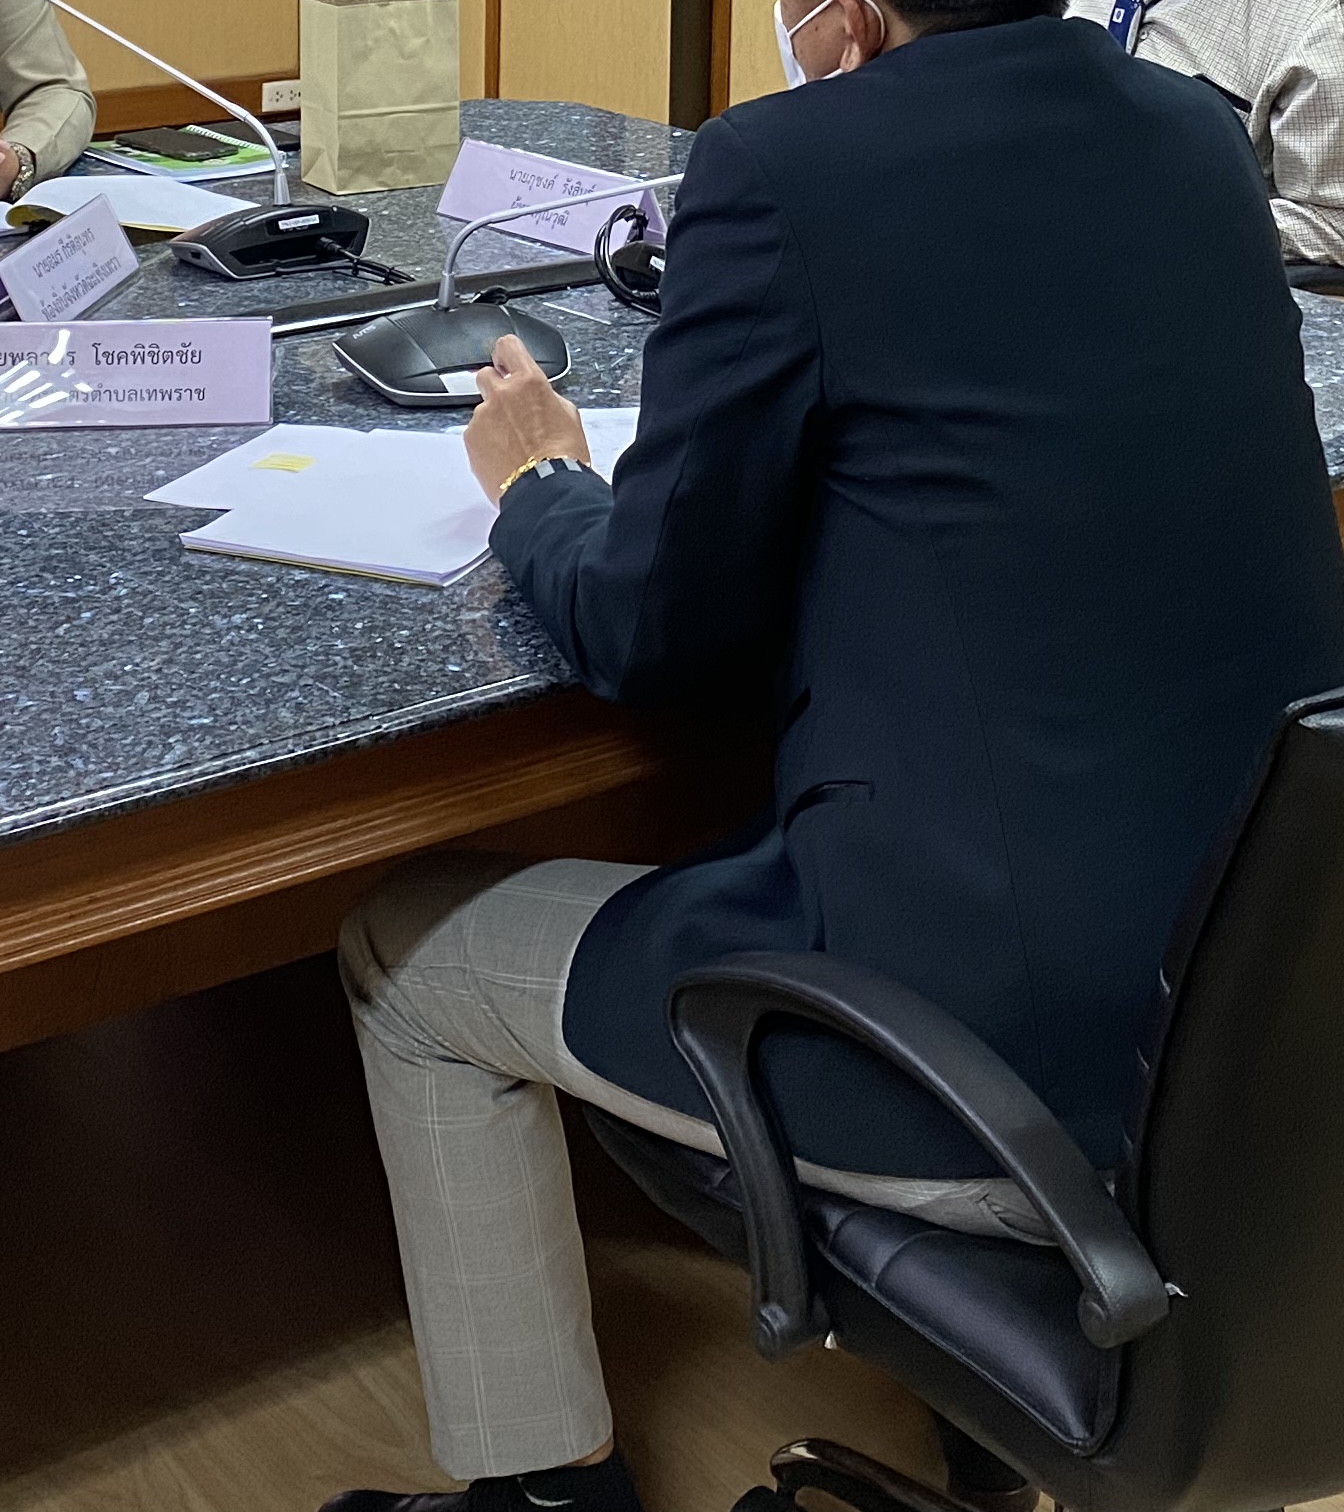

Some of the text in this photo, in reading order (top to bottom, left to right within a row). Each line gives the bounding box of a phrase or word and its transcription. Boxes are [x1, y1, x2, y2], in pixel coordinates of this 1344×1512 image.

[91, 341, 203, 366] โชคพิชิตชัย
